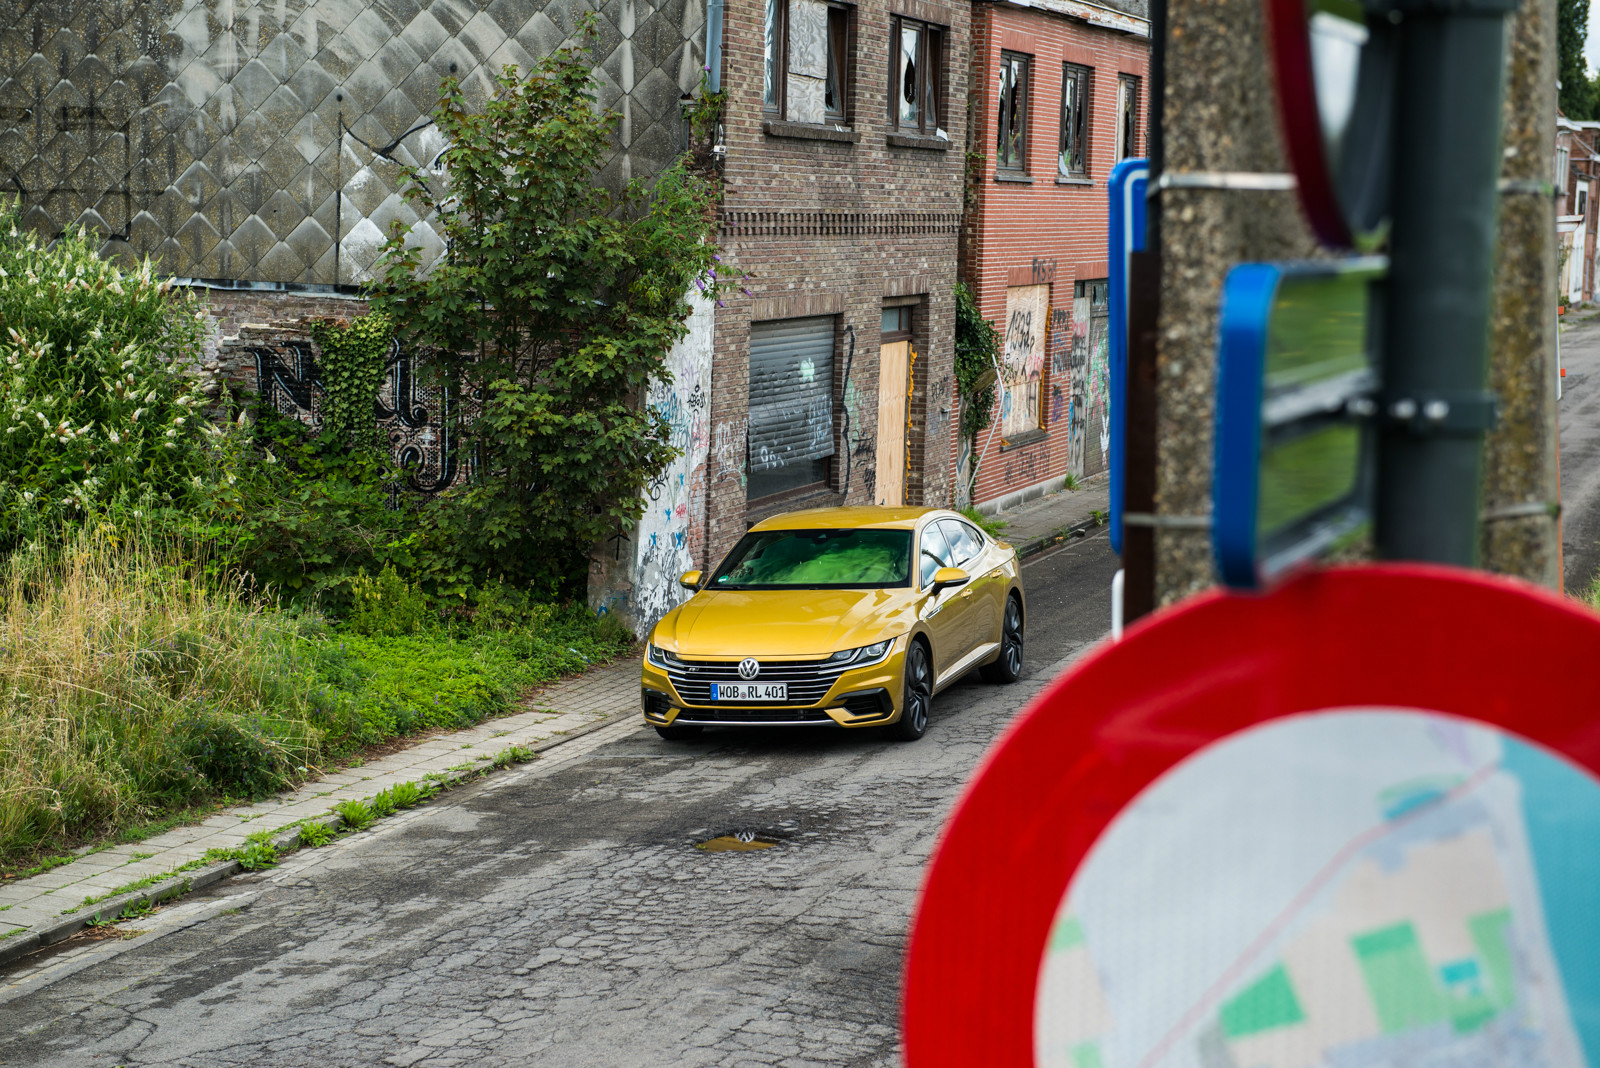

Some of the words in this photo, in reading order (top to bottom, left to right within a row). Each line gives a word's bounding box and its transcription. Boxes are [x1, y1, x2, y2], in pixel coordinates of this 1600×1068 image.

[719, 686, 739, 698] WOB
[747, 686, 762, 698] RL
[765, 686, 785, 698] 401
